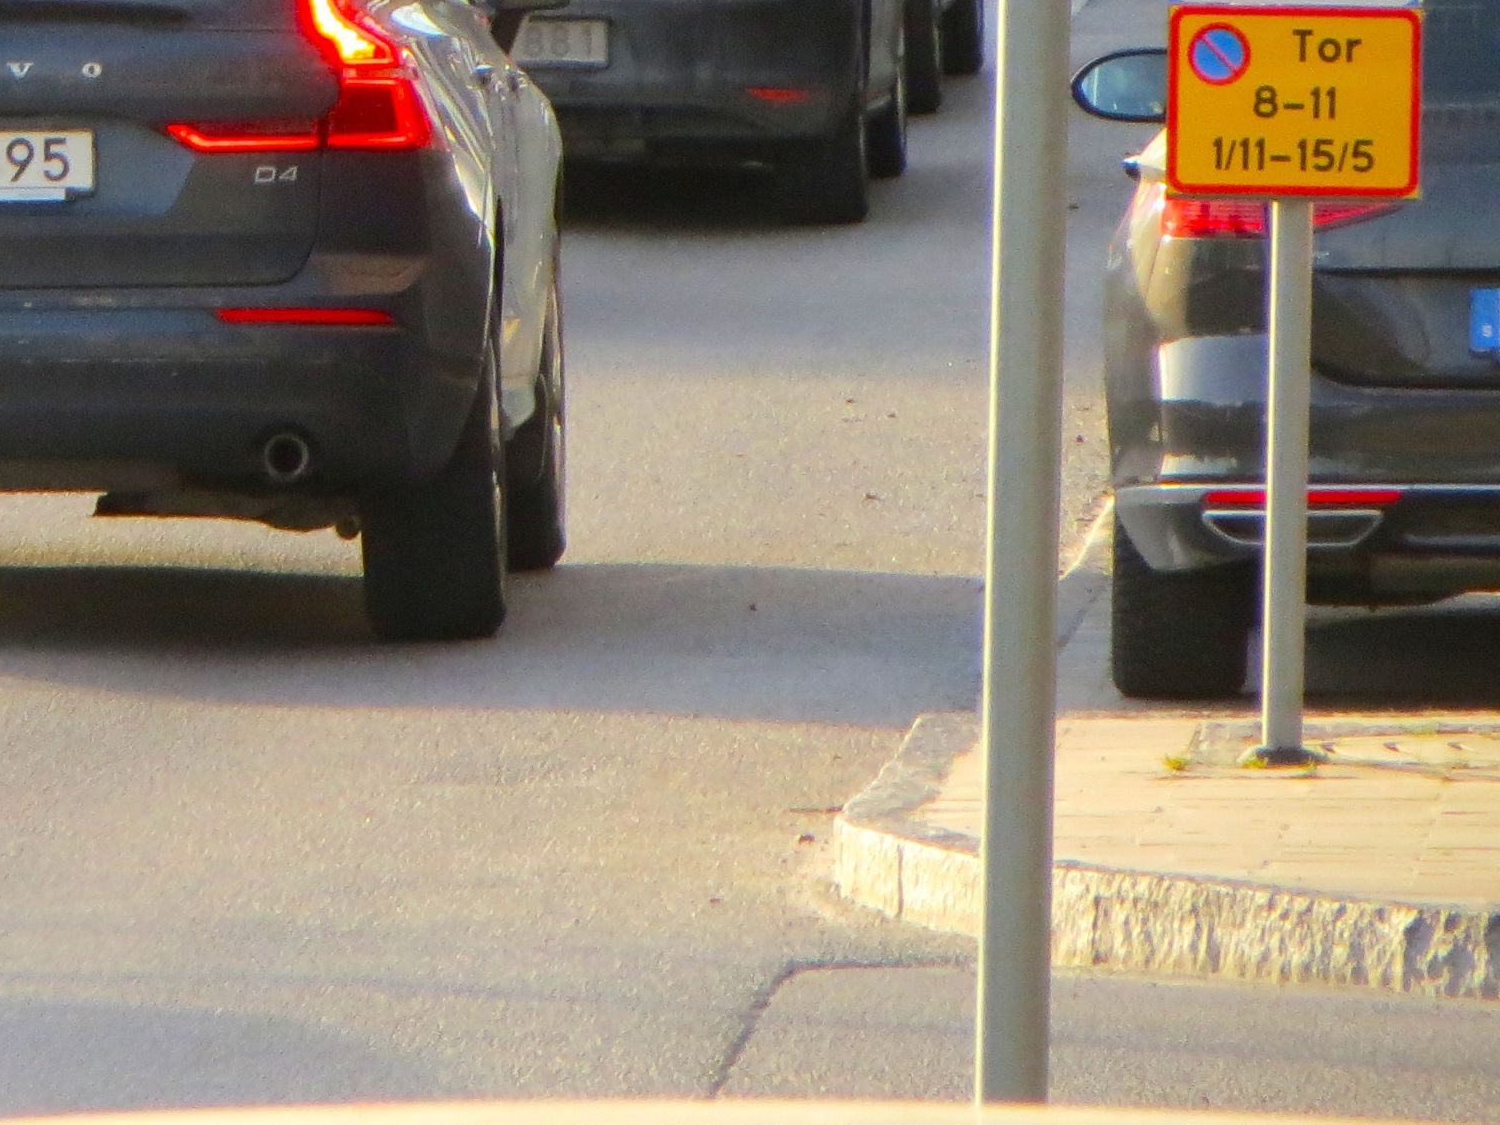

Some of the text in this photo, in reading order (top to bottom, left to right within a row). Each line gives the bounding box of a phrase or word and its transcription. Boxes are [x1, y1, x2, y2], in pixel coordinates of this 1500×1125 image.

[1292, 29, 1362, 63] Tor
[1253, 85, 1336, 119] 8-11
[1213, 136, 1374, 173] 1/11-15/5
[254, 166, 299, 184] D4
